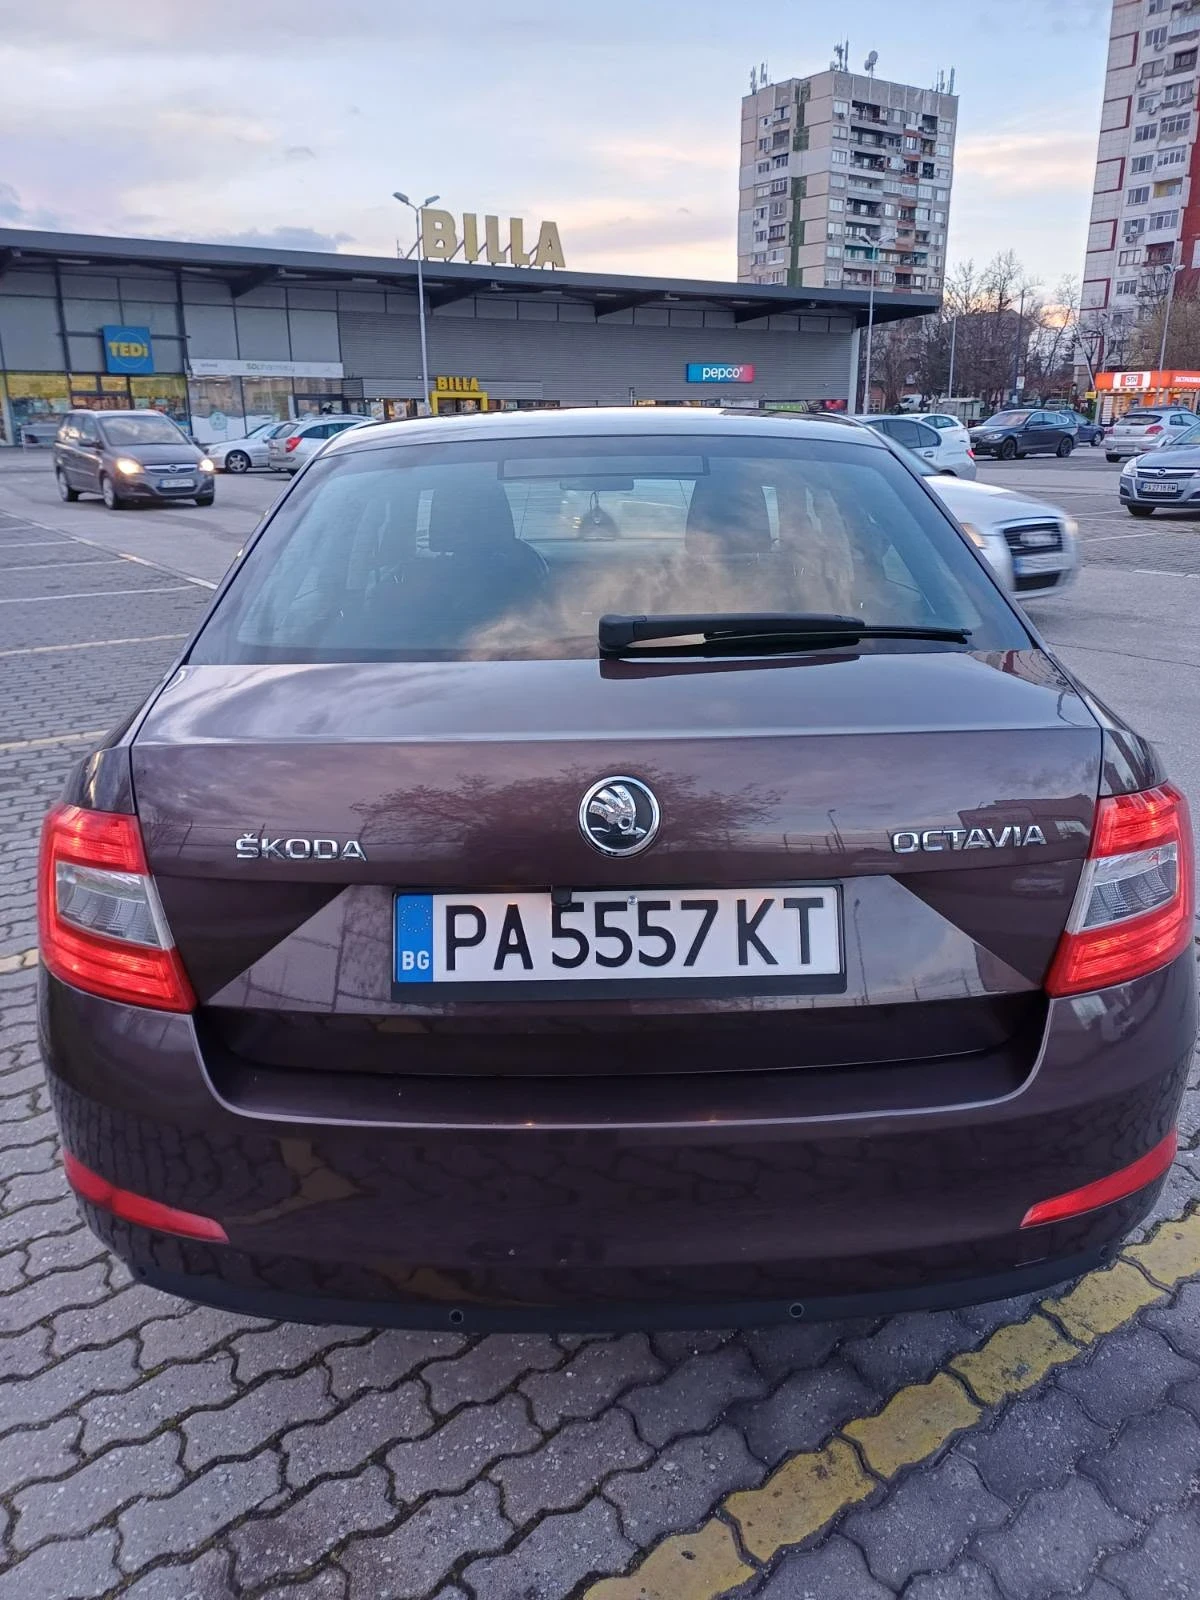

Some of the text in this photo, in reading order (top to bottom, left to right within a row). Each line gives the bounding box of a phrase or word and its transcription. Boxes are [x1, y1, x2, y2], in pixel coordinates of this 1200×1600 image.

[421, 208, 566, 268] BILLA
[108, 341, 149, 358] TEDi
[437, 375, 479, 391] BILLA
[702, 366, 741, 381] pepco
[235, 833, 367, 861] ŠKODA
[892, 825, 1048, 854] OCTAVIA
[445, 897, 824, 971] PA 5557 KT
[401, 950, 430, 971] BG
